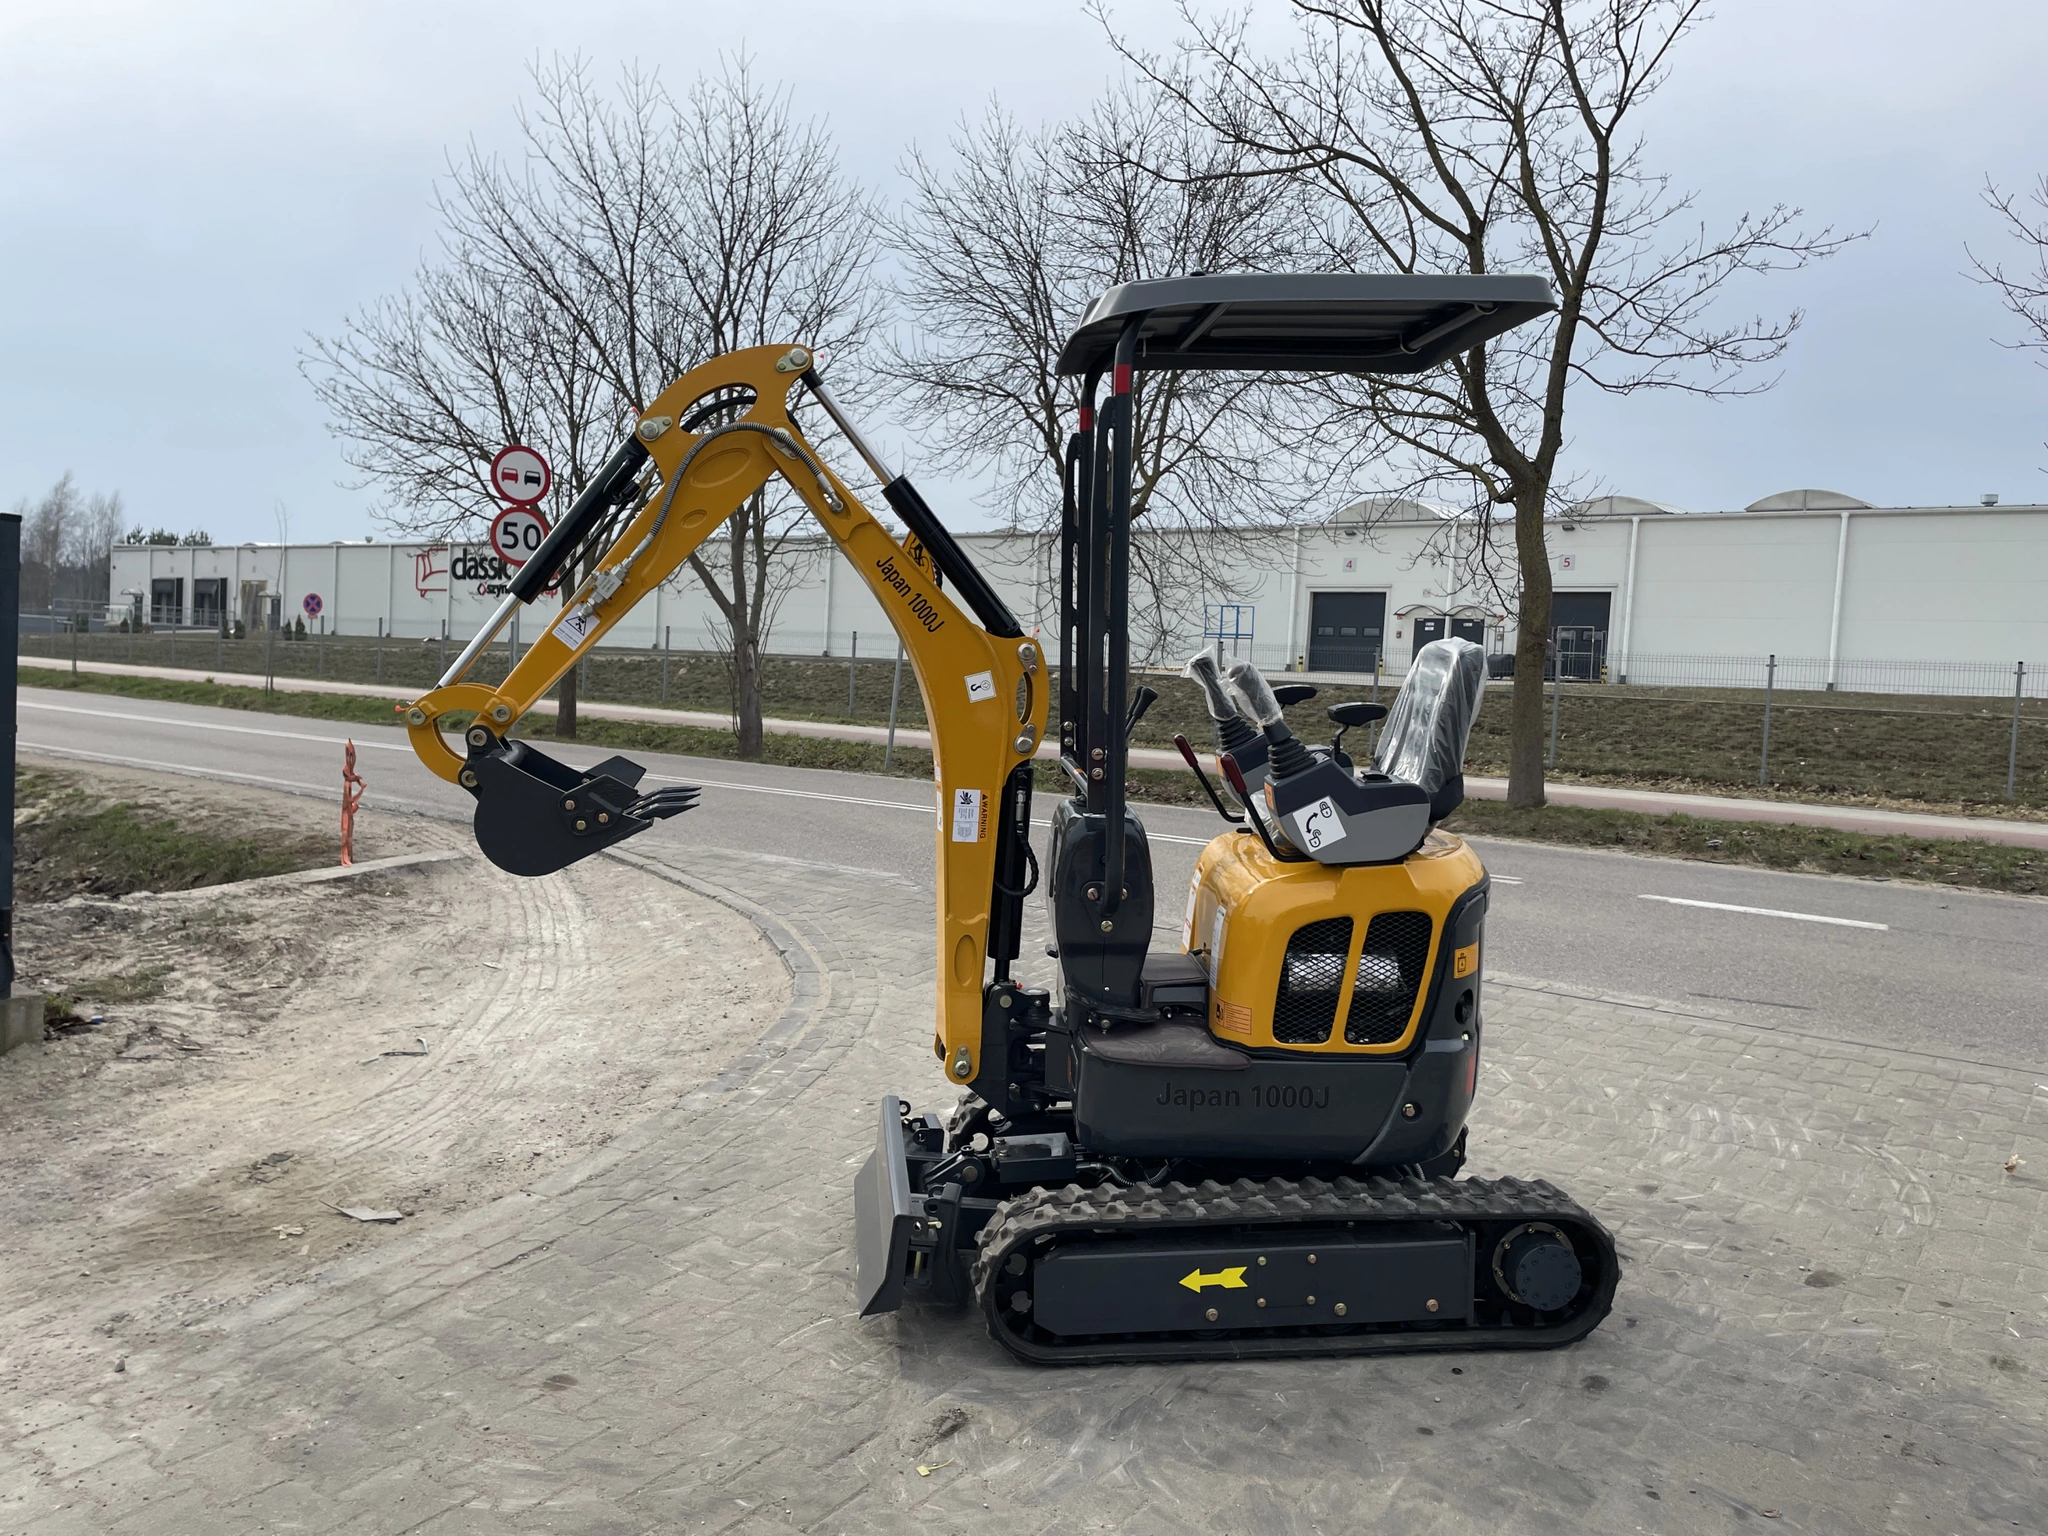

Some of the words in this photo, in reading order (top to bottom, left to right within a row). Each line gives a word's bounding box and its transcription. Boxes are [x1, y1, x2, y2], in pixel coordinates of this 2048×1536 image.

[501, 521, 541, 551] 50
[1345, 559, 1353, 570] 4
[1563, 557, 1571, 568] 5
[486, 584, 511, 598] szyn
[876, 556, 911, 598] Japan
[907, 592, 945, 633] 1000J
[979, 802, 989, 839] WARNING
[1156, 1082, 1240, 1111] Japan
[1251, 1085, 1330, 1109] 1000J
